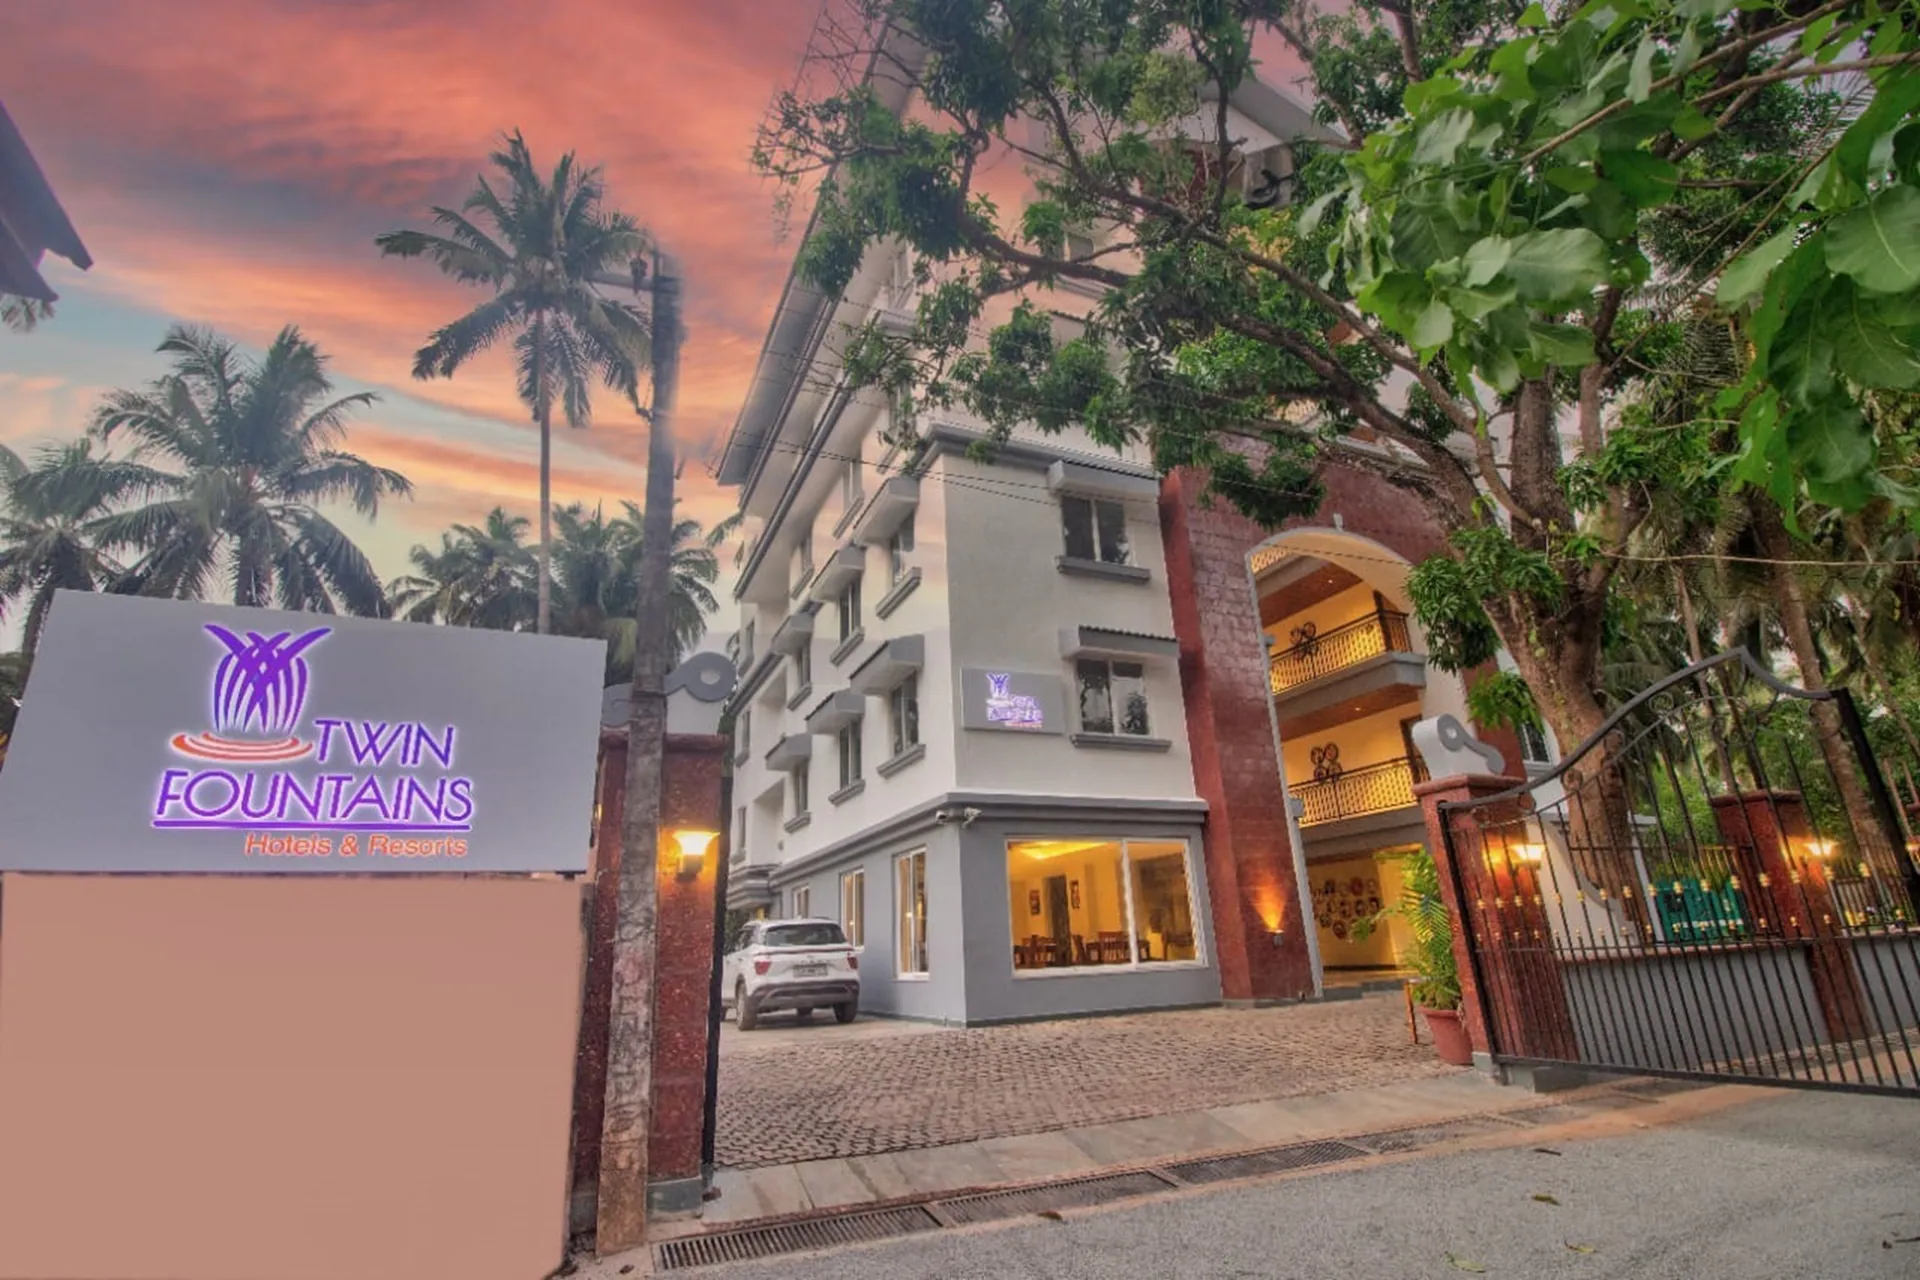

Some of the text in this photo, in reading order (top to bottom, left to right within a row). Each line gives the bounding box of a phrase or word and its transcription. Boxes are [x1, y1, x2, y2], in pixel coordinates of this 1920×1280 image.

[315, 719, 454, 768] TWIN
[156, 769, 473, 822] FOUNTAINS
[245, 833, 468, 857] Hotels & Resorts
